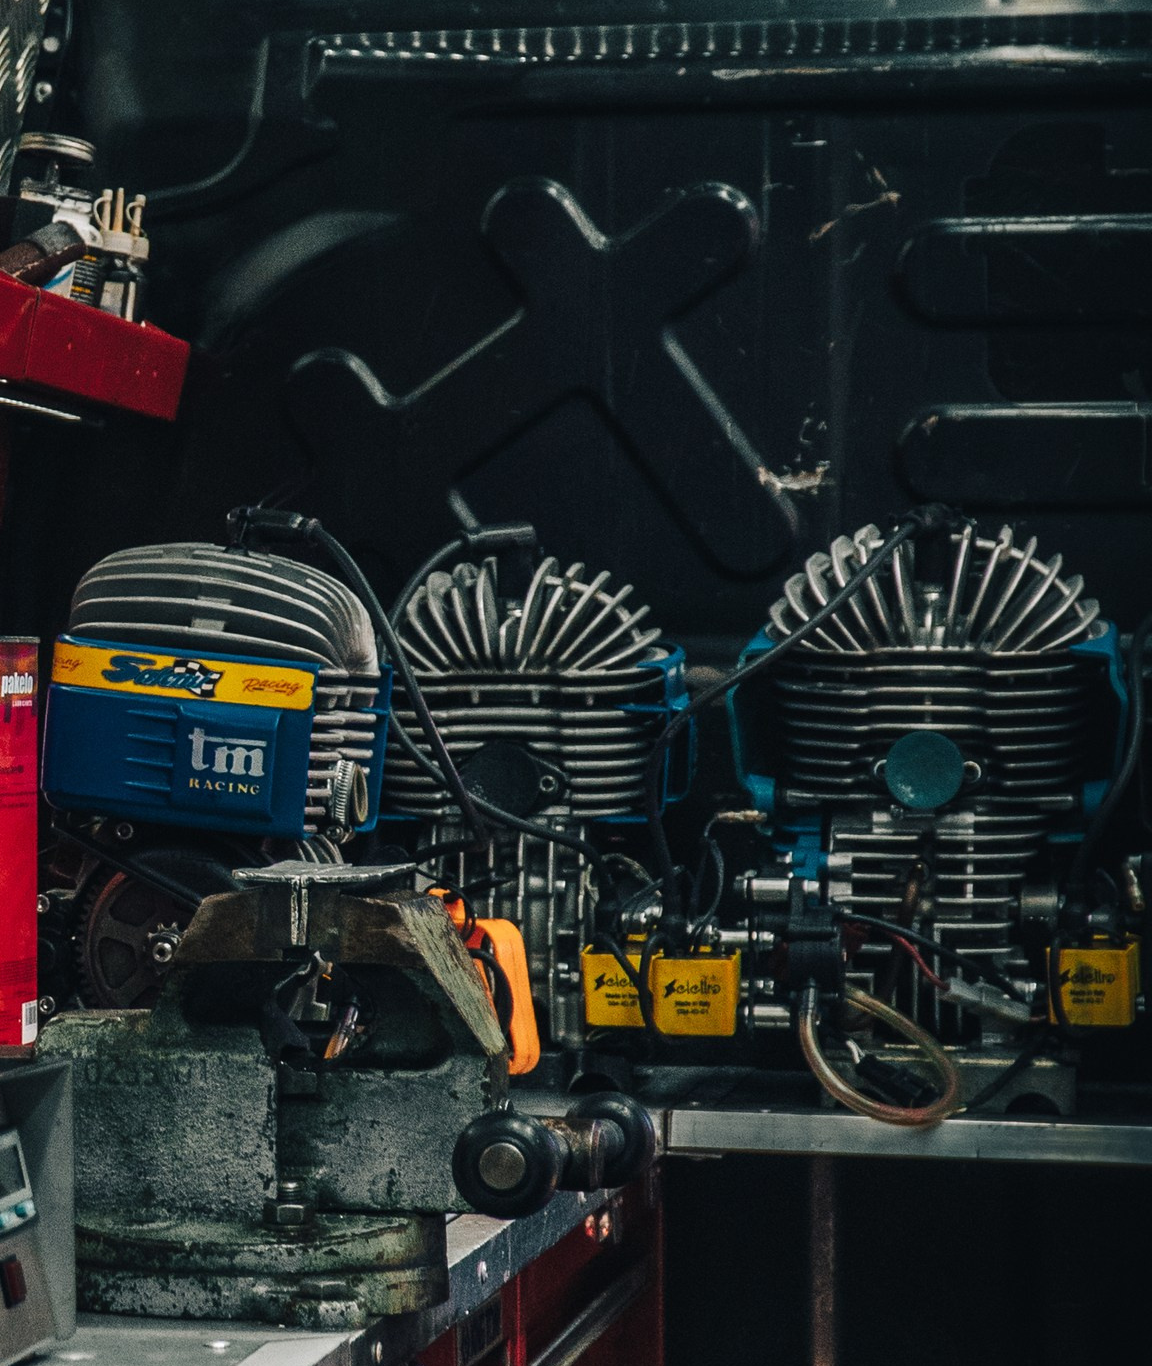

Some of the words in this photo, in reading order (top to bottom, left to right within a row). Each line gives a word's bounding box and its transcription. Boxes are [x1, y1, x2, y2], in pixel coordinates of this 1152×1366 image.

[1, 672, 33, 697] pakelo
[242, 677, 304, 696] Racing
[189, 777, 261, 795] RACING
